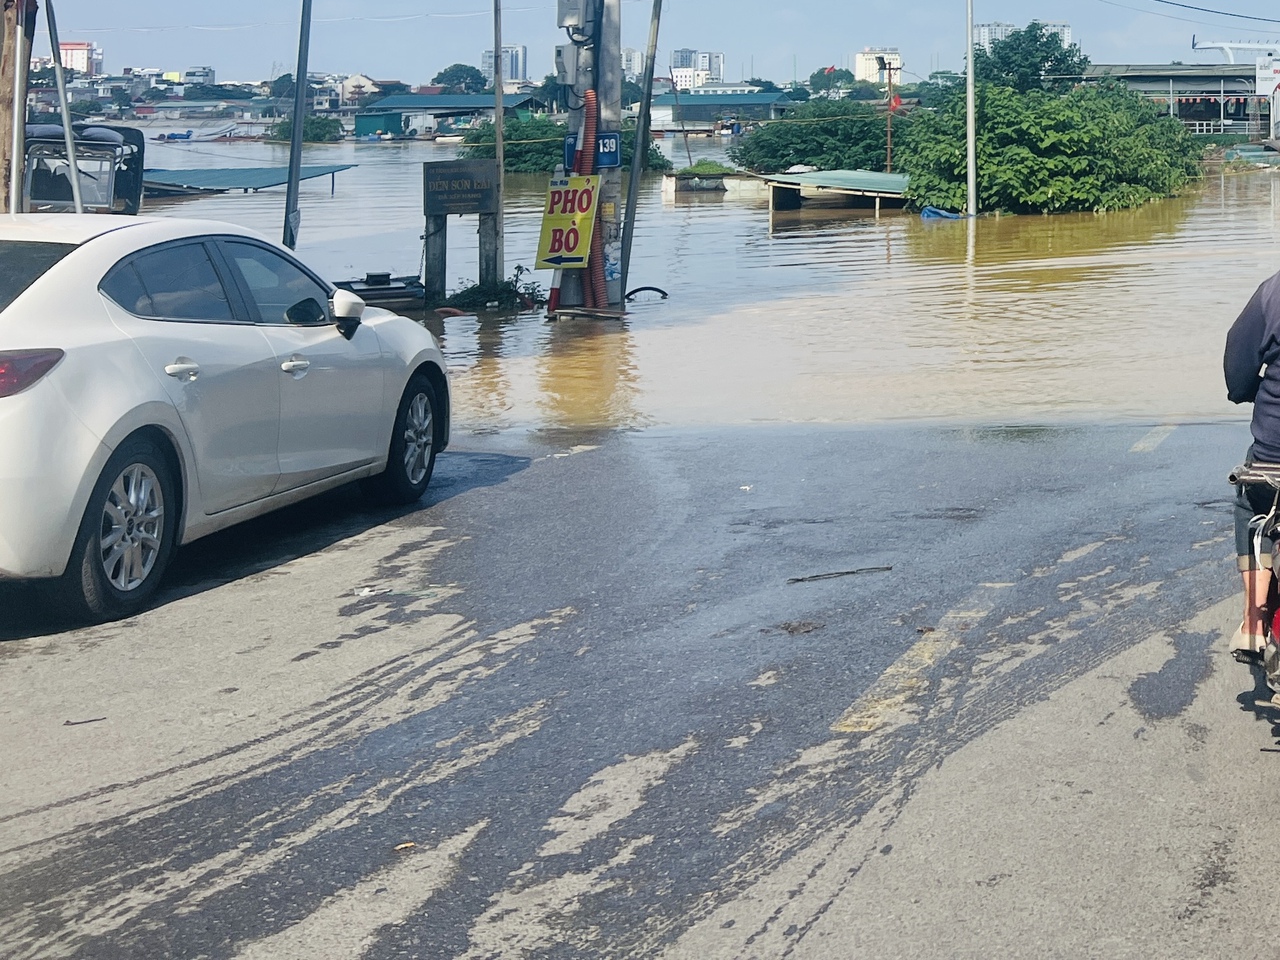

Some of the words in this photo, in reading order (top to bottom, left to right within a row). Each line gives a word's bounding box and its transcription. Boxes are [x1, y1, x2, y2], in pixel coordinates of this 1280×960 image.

[599, 139, 616, 153] 139
[547, 177, 595, 215] PHỞ
[548, 220, 579, 254] BÒ
